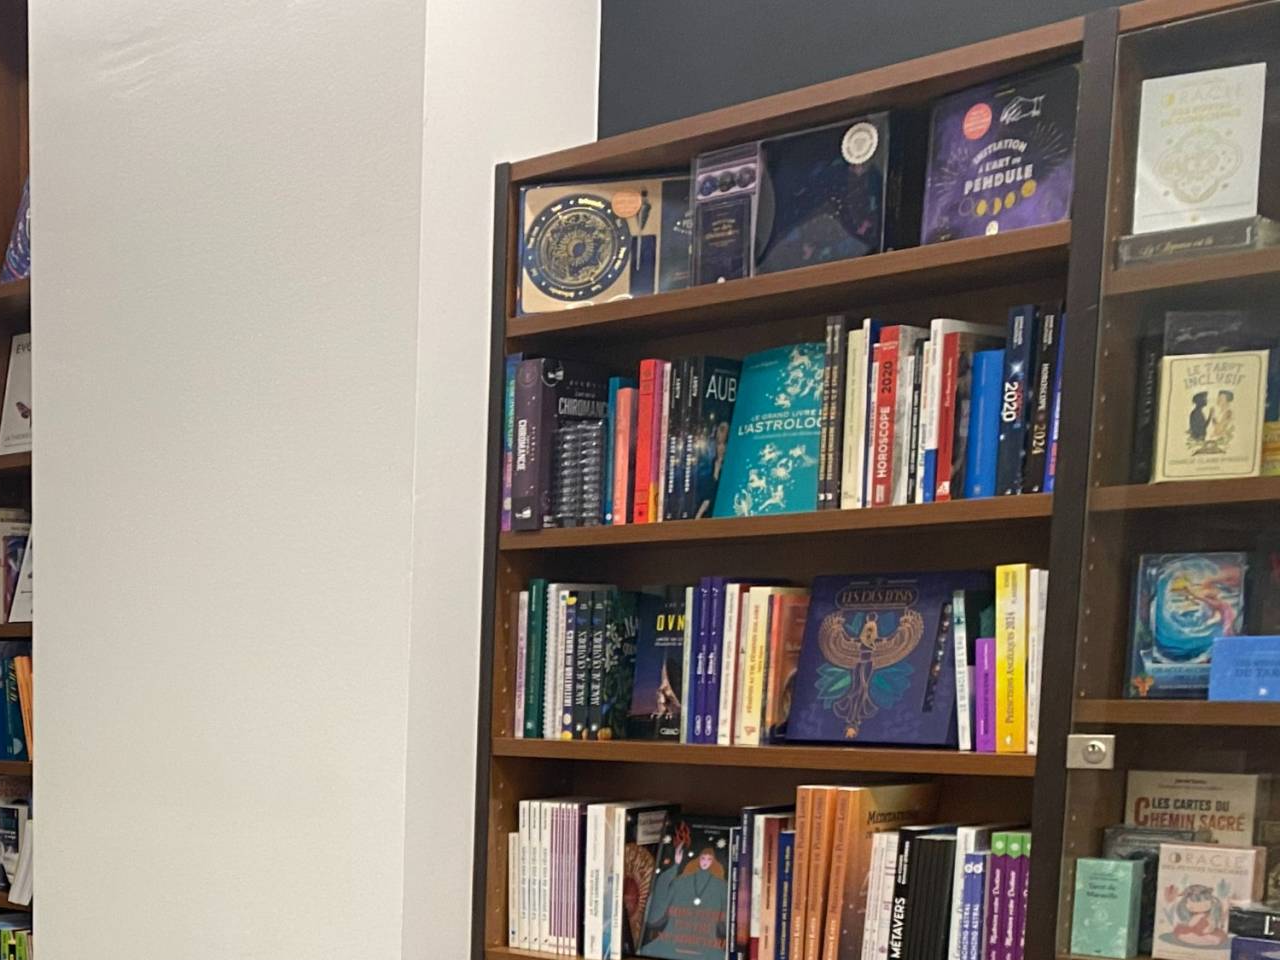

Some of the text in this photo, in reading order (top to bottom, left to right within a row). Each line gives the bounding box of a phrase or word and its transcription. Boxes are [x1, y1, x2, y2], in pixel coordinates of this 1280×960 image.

[964, 163, 1034, 196] PENDULE
[1184, 373, 1246, 387] INCLUSIF
[1205, 362, 1245, 376] TAROT
[1003, 381, 1019, 423] 2020
[1038, 363, 1050, 412] HOROSCOPE
[558, 397, 608, 417] CHIROMANC
[876, 360, 893, 478] HOROSCOPE 2020
[1032, 424, 1046, 456] 2024
[1133, 796, 1246, 832] CHEMIN SACRÉ
[1152, 797, 1230, 812] LES CARTES DU
[890, 896, 906, 959] MÉTAVERS
